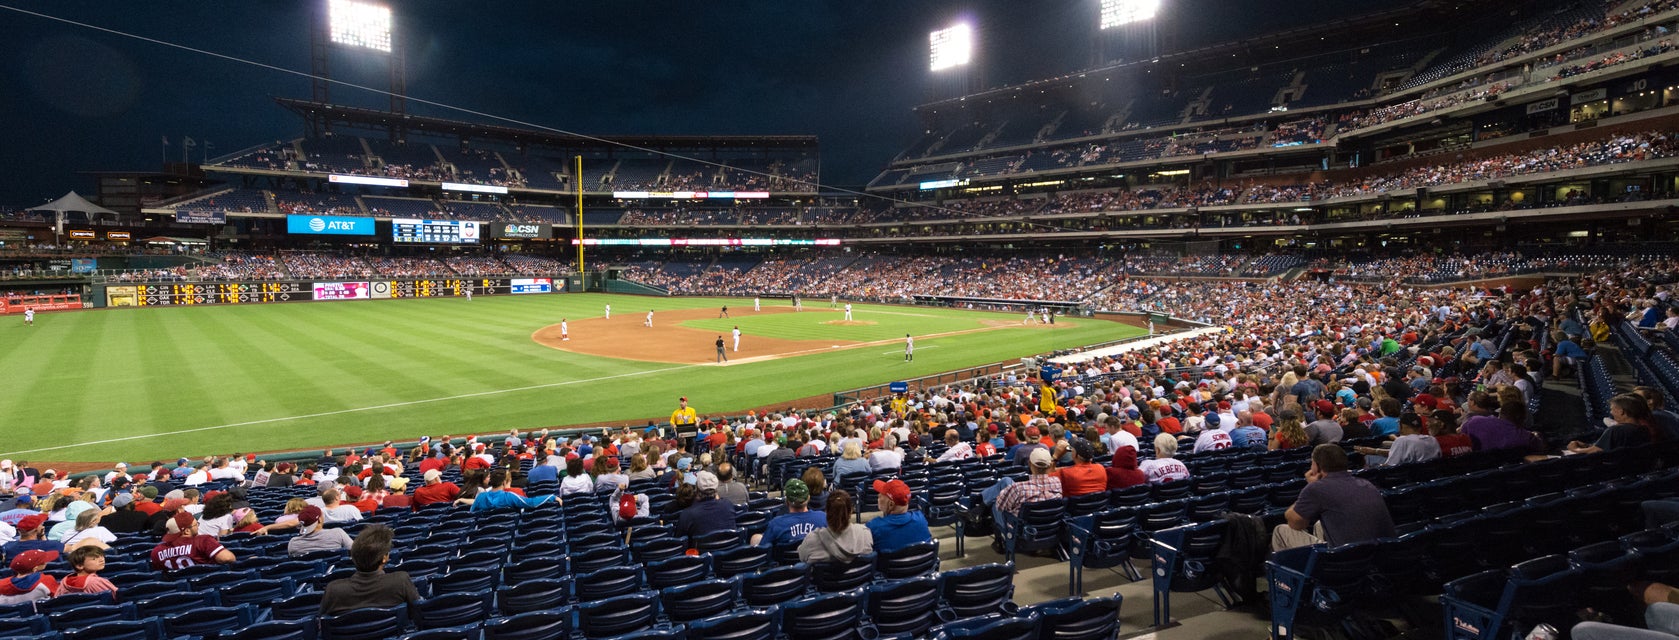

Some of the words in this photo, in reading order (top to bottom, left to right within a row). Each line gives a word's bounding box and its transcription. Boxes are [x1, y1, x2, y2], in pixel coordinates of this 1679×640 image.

[1633, 79, 1648, 92] 10
[1539, 101, 1556, 111] CSN
[328, 221, 356, 230] AT&T
[517, 225, 540, 234] CSN
[790, 522, 815, 537] UTLEY
[157, 544, 193, 561] DAULTON
